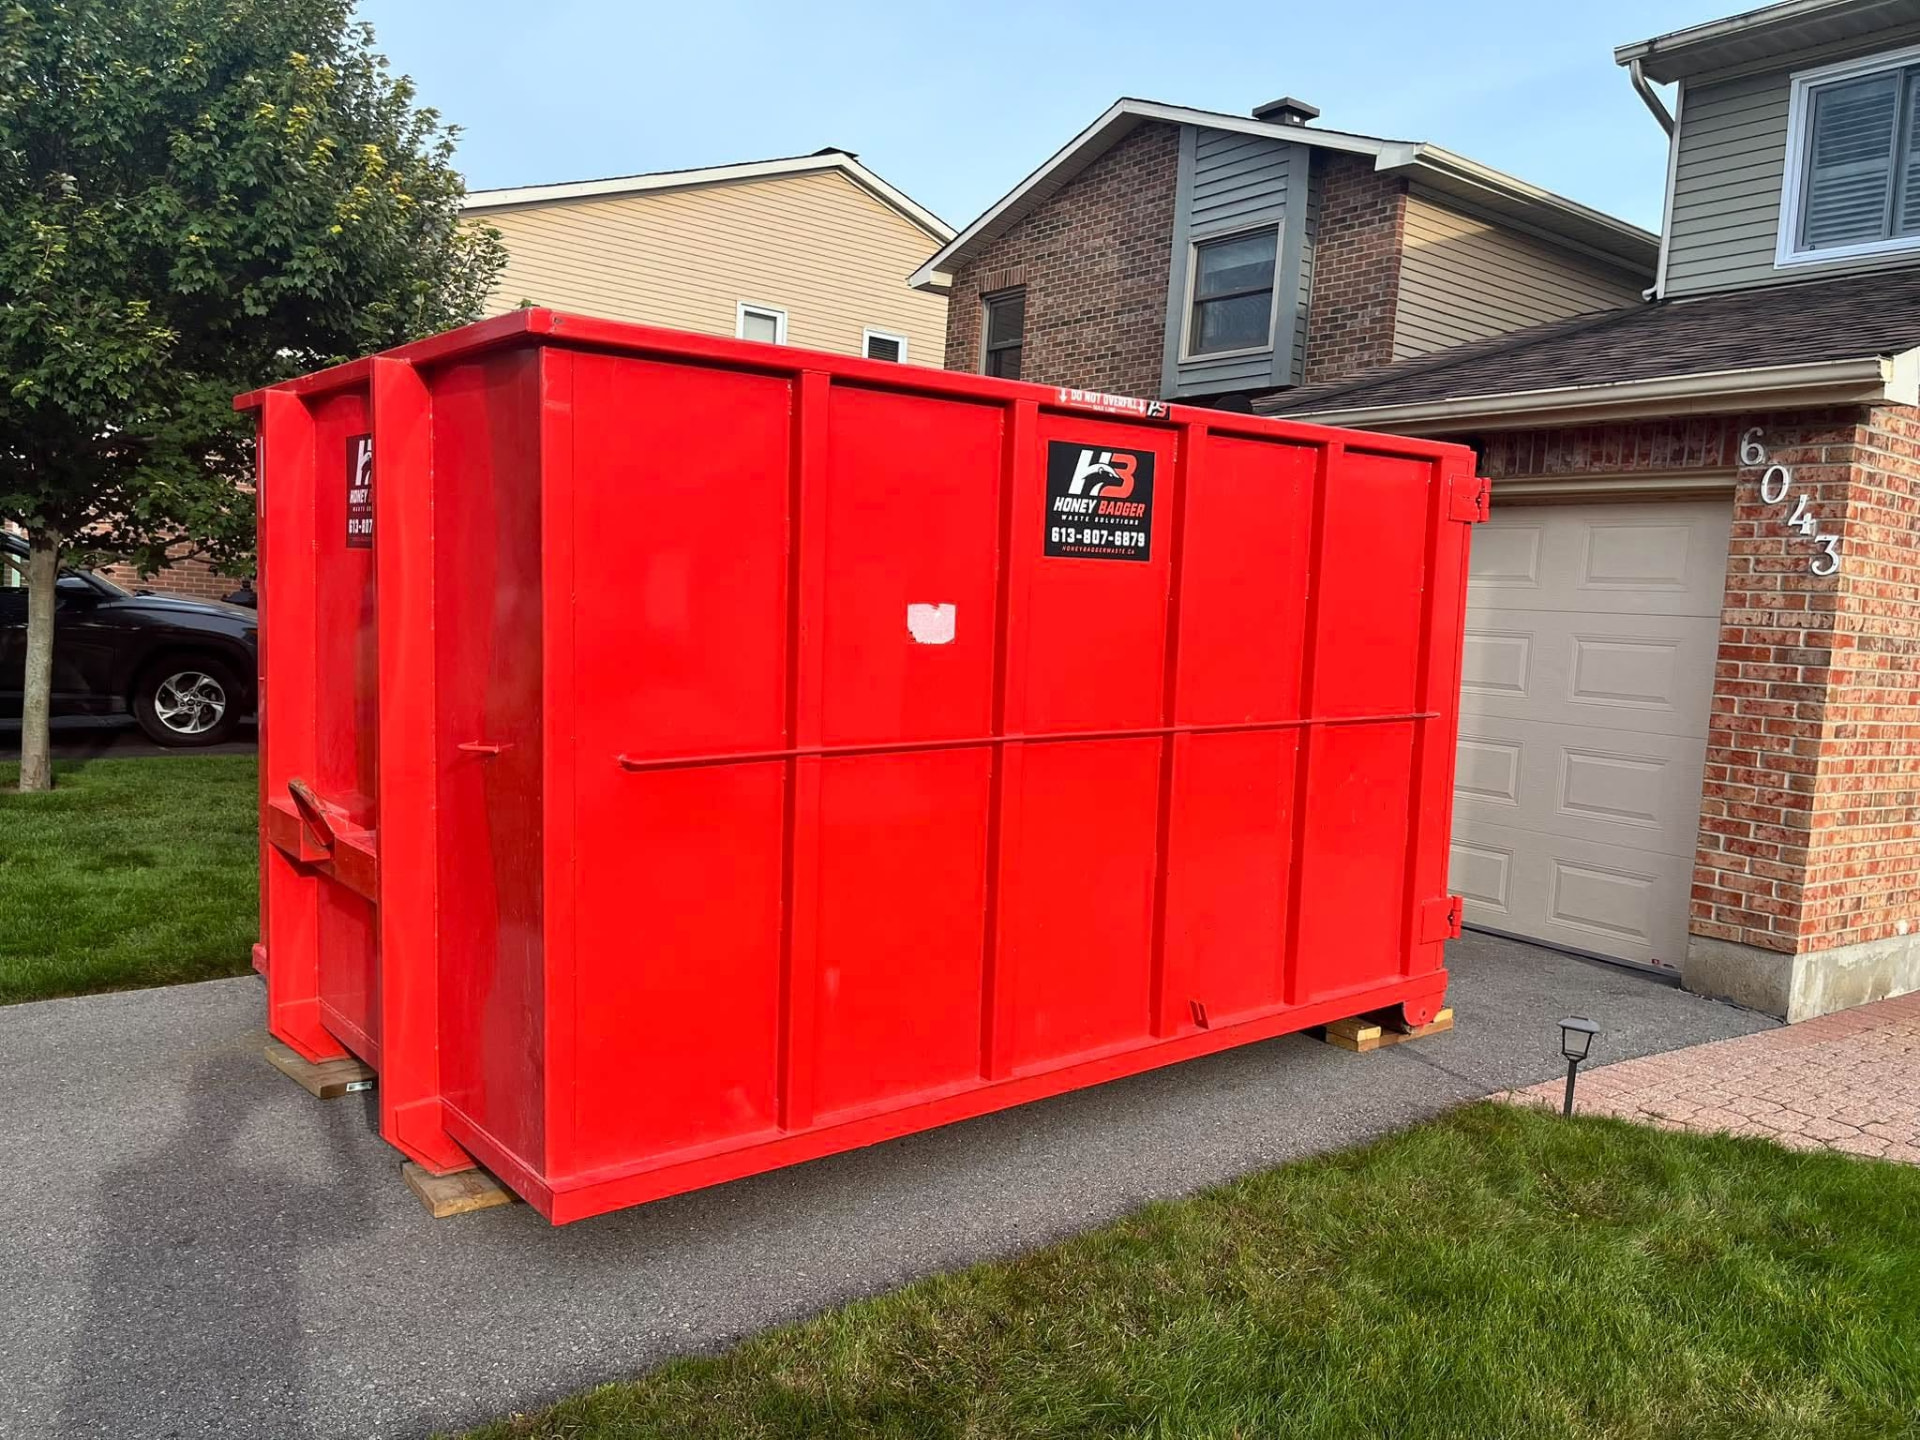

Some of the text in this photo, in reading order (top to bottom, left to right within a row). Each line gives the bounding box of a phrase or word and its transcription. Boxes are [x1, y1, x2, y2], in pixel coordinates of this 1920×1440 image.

[1070, 389, 1083, 401] DO
[1084, 390, 1100, 404] NOT
[1103, 393, 1137, 410] OVERFILL
[1053, 496, 1146, 517] HONEY BADGER
[1740, 427, 1840, 576] 6043
[1061, 514, 1139, 526] WASTE SOLUTIONS
[1051, 526, 1145, 548] 613-807-6879
